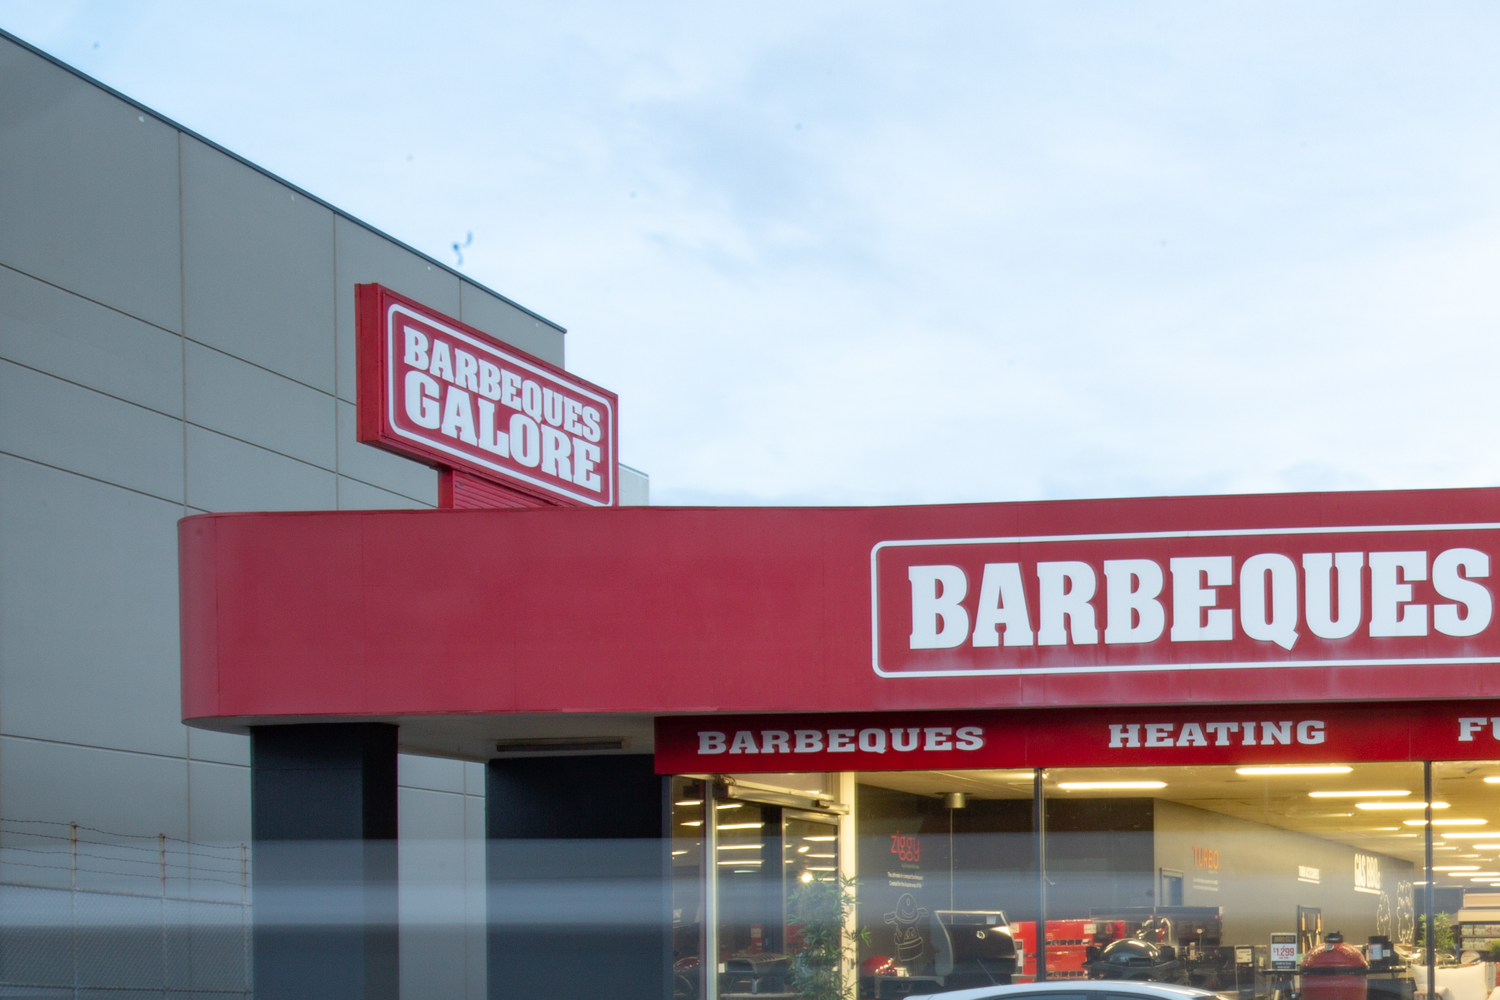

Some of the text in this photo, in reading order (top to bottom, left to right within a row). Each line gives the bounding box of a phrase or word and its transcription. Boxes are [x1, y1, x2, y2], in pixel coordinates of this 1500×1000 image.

[404, 325, 600, 442] BARBEQUES
[405, 370, 601, 493] GALORE
[908, 547, 1493, 651] BARBEQUES
[698, 726, 984, 755] BARBEQUES
[1108, 720, 1326, 748] HEATING
[891, 830, 920, 862] ziggy
[1192, 846, 1219, 870] TURBO
